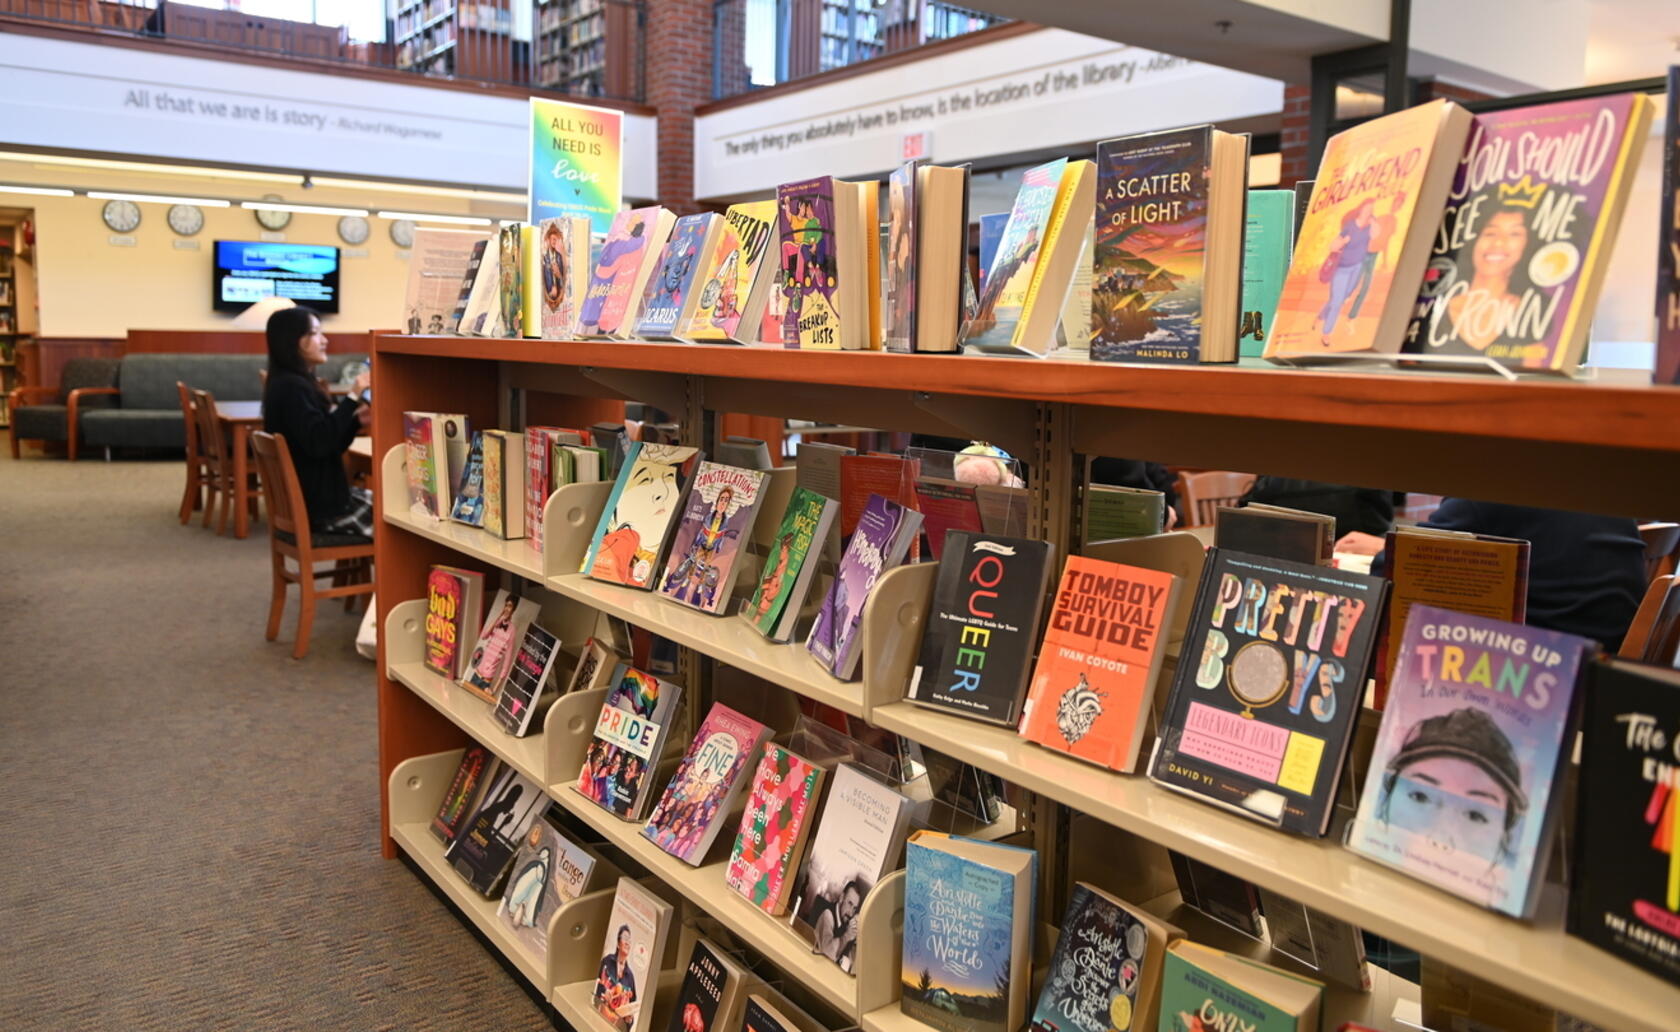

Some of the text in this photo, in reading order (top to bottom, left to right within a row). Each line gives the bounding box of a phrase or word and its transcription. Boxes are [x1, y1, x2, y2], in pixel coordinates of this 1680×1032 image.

[124, 90, 149, 108] All
[155, 92, 195, 113] that
[199, 101, 227, 117] we
[231, 104, 260, 120] are
[265, 104, 278, 122] is
[283, 110, 327, 131] story
[725, 141, 740, 156] The
[741, 138, 760, 155] only
[761, 134, 784, 151] thing
[786, 133, 803, 149] you
[805, 116, 857, 141] absolutely
[857, 113, 883, 130] have
[885, 110, 897, 125] to
[937, 98, 947, 115] is
[950, 93, 971, 112] the
[974, 83, 1031, 108] location
[1033, 73, 1051, 95] of
[1053, 73, 1079, 93] the
[1082, 60, 1137, 87] library
[551, 117, 604, 136] ALL YOU
[552, 137, 602, 156] NEED IS
[1448, 108, 1616, 200] YOU SHOULD
[551, 159, 601, 183] love
[1105, 171, 1191, 200] A SCATTER
[1311, 147, 1421, 214] GIRLFRIEND
[1111, 201, 1182, 226] OF LIGHT
[1434, 190, 1587, 254] SEE ME
[799, 311, 829, 333] BREAKUP
[1428, 280, 1565, 347] CROWN
[812, 326, 834, 344] LISTS
[1136, 349, 1189, 359] MALINDA LO
[807, 501, 822, 520] THE
[1066, 569, 1164, 608] TOMBOY
[940, 611, 948, 619] The
[984, 619, 997, 628] Guide
[950, 556, 1004, 692] QUEER
[1058, 590, 1156, 630] SURVIVAL
[1210, 572, 1367, 658] PRETTY
[426, 612, 456, 643] GAYS
[1052, 610, 1154, 651] GUIDE
[1058, 647, 1129, 675] IVAN COYOTE
[1421, 624, 1562, 667] GROWING UP
[1415, 644, 1558, 710] TRANS
[600, 708, 654, 747] PRIDE
[1190, 707, 1283, 753] LEGENDARY ICONS
[697, 743, 734, 777] FINE
[766, 743, 779, 761] We
[759, 761, 781, 786] Have
[1168, 763, 1214, 786] DAVID YI
[752, 782, 783, 811] Always
[845, 795, 870, 816] VISIBLE
[872, 811, 888, 825] MAN
[853, 787, 891, 815] BECOMING
[746, 801, 769, 827] Been
[782, 820, 799, 863] MUSLIM
[797, 771, 815, 815] MEMOIR
[741, 821, 761, 845] Here
[559, 848, 584, 885] tango
[730, 849, 760, 881] Samra
[929, 878, 982, 911] Aristotle
[929, 901, 970, 922] Dante
[939, 916, 980, 941] Waters
[1077, 925, 1125, 961] Aristotle
[1605, 913, 1626, 932] THE
[1627, 922, 1680, 957] LGBTQIA
[700, 956, 720, 980] JONNY
[926, 934, 983, 970] World
[1073, 947, 1116, 979] Dante
[688, 962, 721, 1003] APPLESEED
[1071, 974, 1109, 1011] Secrets
[1184, 972, 1208, 992] ABDI
